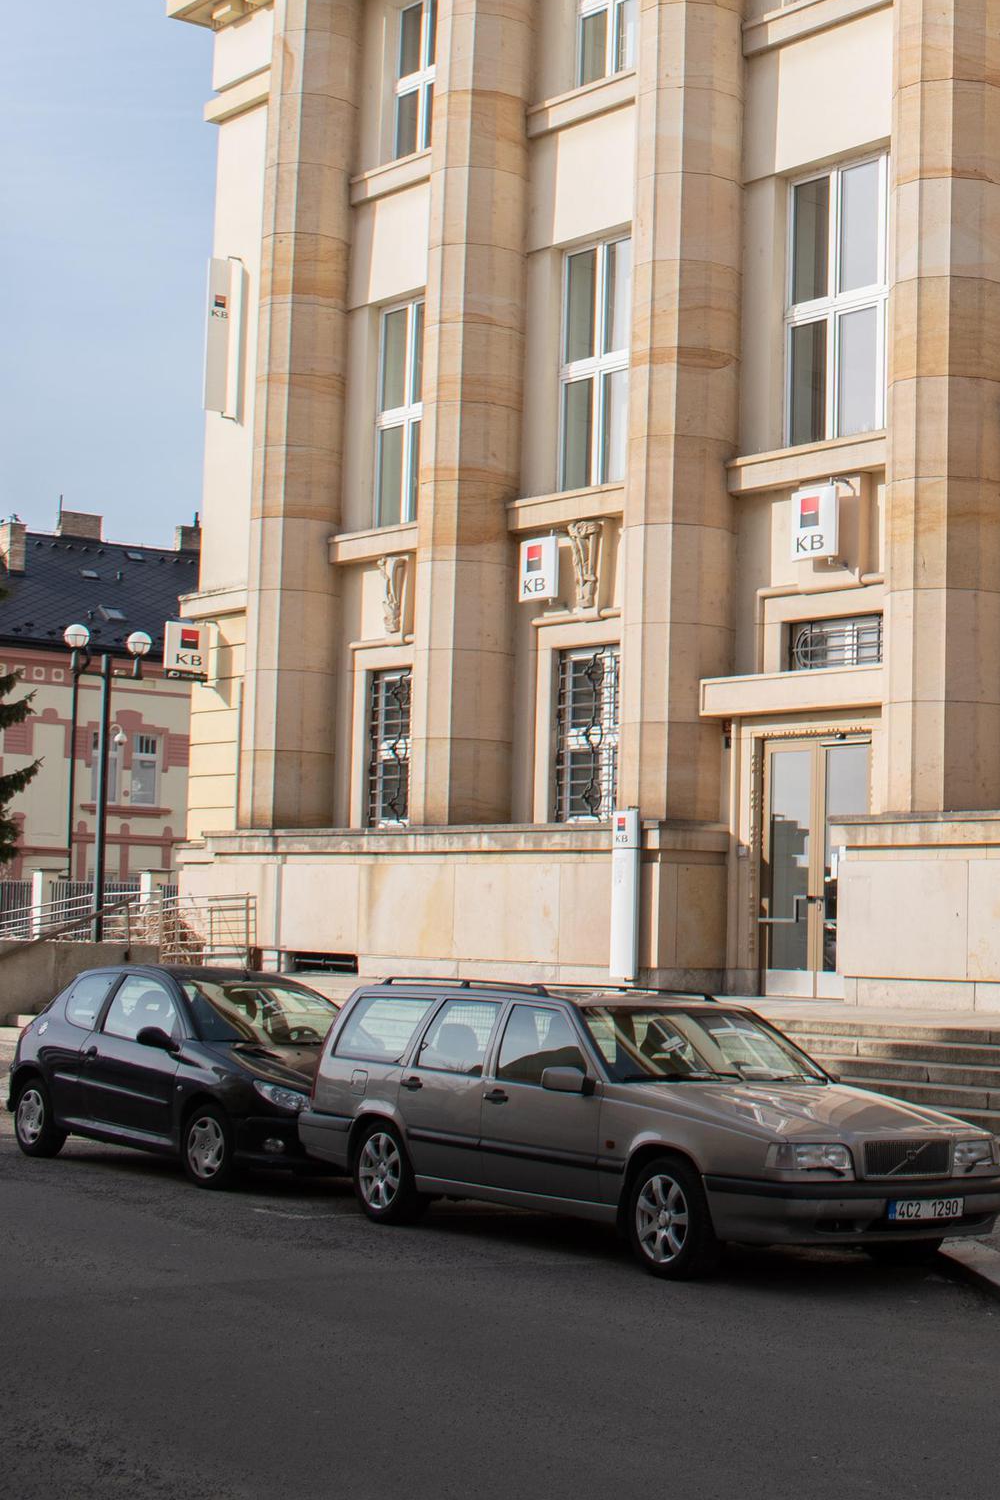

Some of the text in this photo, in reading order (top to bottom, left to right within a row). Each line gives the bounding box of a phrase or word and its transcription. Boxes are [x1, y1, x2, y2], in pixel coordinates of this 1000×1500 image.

[211, 310, 229, 319] KB
[796, 534, 824, 553] KB
[523, 577, 545, 594] KB
[176, 653, 202, 666] KB
[615, 835, 628, 843] KB
[898, 1202, 921, 1218] 4C2
[931, 1200, 959, 1217] 1290
